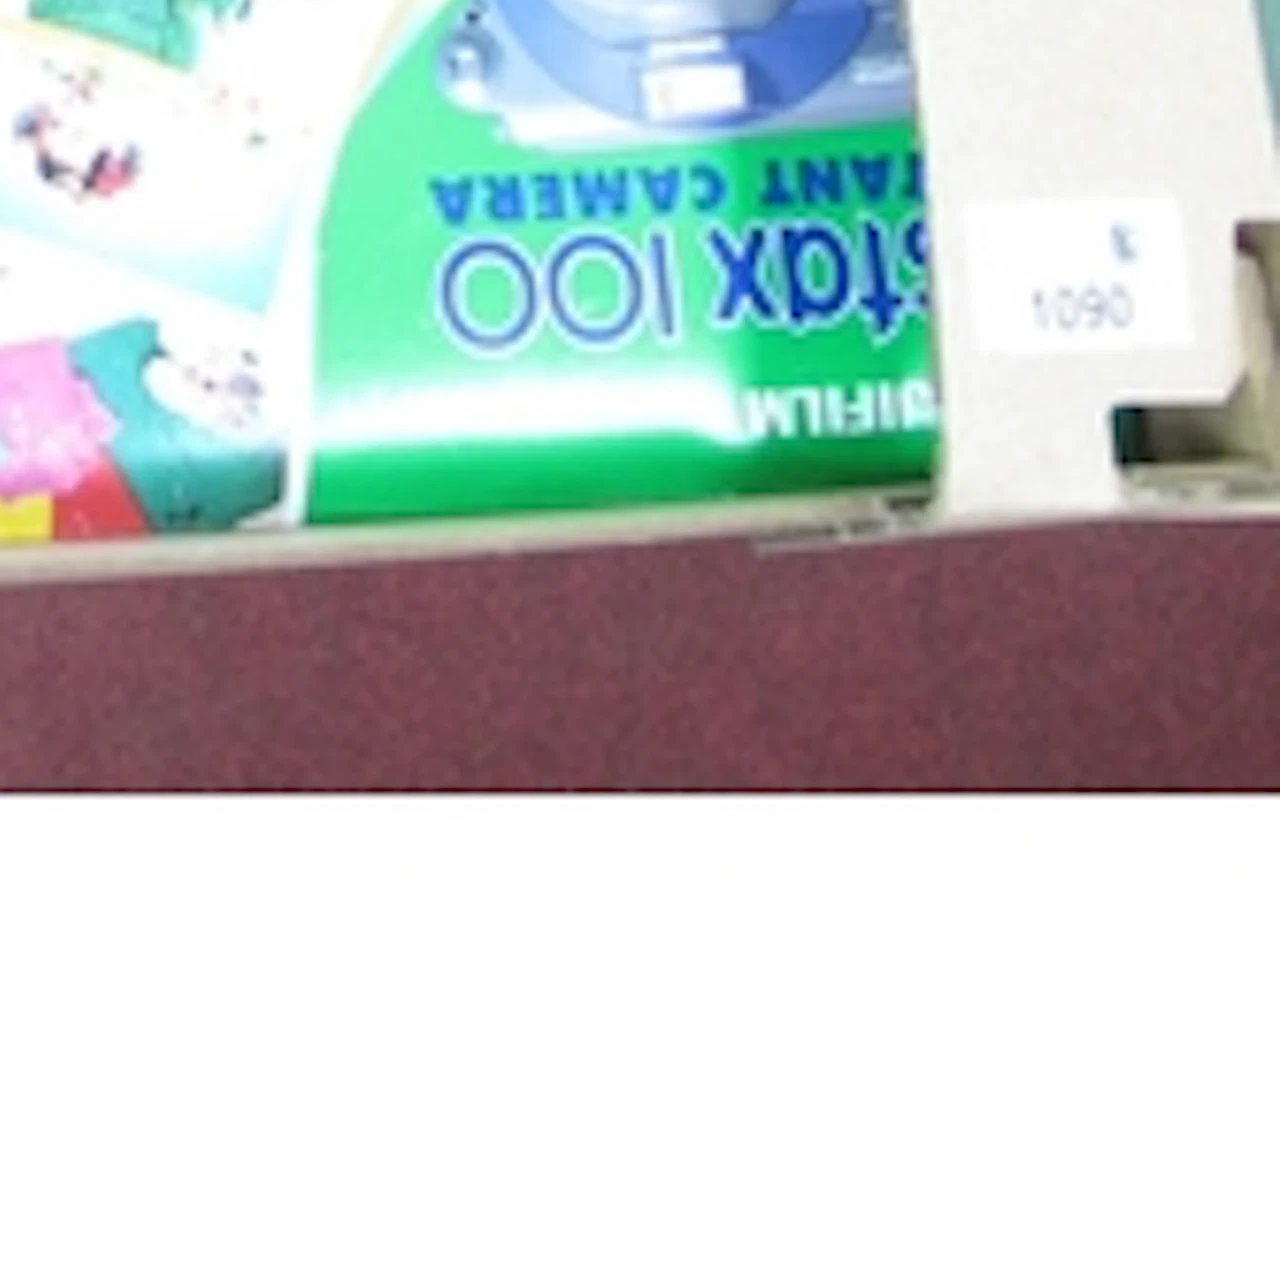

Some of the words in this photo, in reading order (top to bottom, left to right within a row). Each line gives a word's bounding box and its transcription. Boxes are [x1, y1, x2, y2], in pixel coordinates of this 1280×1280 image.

[428, 164, 725, 226] CAMERA
[439, 232, 678, 351] 100
[1031, 282, 1135, 331] 1090
